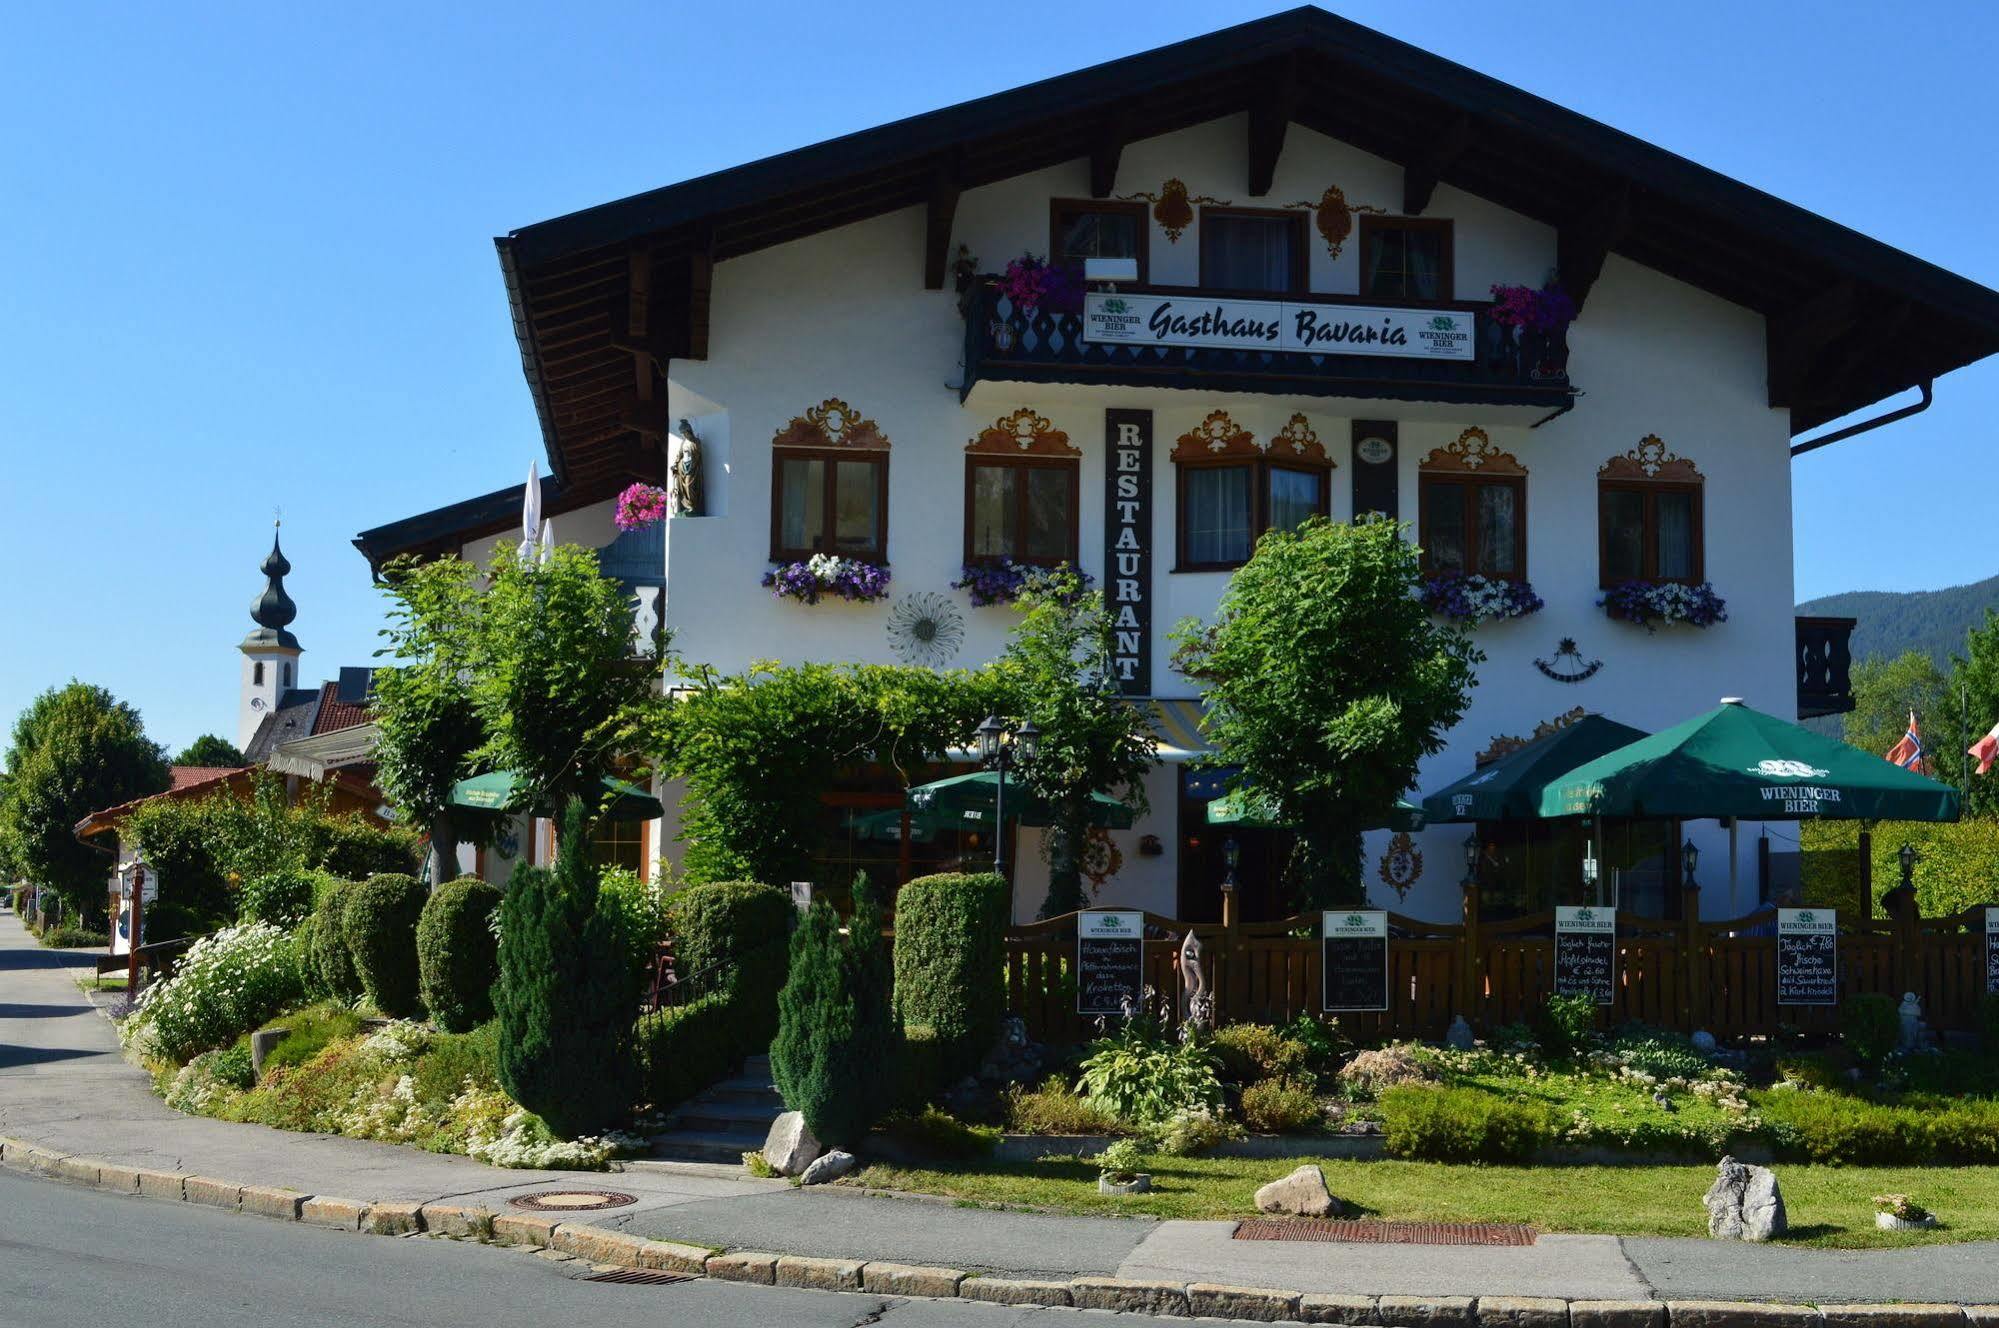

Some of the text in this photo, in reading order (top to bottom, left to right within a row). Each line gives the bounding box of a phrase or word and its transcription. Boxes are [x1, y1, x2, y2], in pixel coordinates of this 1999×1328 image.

[1090, 314, 1141, 324] WIENINGER
[1105, 323, 1126, 331] BIER
[1148, 302, 1407, 347] Gasthaus Bavaria
[1419, 331, 1468, 341] WIENINGER
[1433, 340, 1453, 348] BIER
[1115, 423, 1143, 680] RESTAURANT
[1760, 786, 1842, 802] WIENINGER
[1784, 799, 1819, 813] BIER
[1558, 921, 1612, 929] WIENINGER BIER
[1781, 922, 1833, 930] WIENINGER BIER
